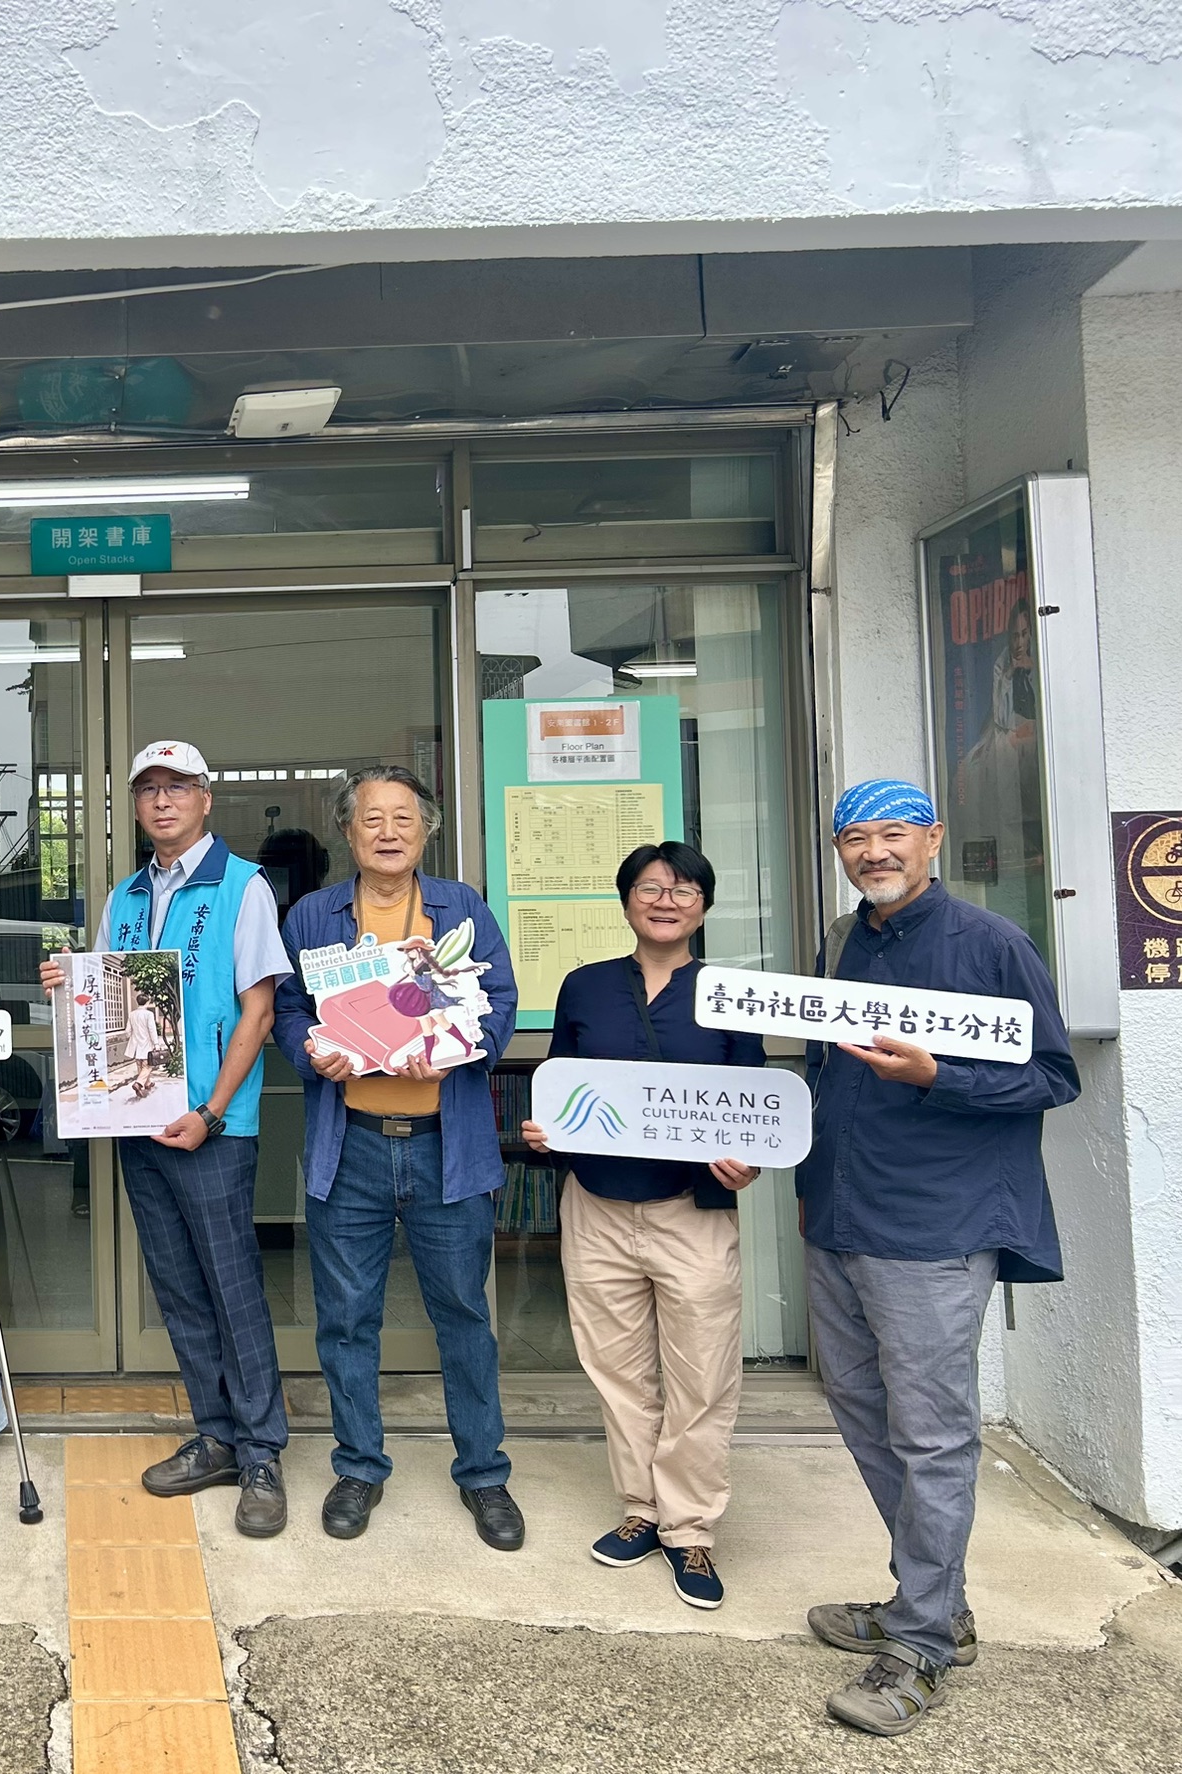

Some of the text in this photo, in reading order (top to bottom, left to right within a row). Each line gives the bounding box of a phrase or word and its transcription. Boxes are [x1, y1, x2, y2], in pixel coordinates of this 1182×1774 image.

[50, 525, 153, 549] 開架書庫
[68, 553, 135, 567] Open Stacks
[561, 742, 605, 751] Floor Plan
[117, 922, 132, 951] 許
[182, 903, 211, 987] 安南區公所
[302, 944, 345, 962] Annan
[304, 947, 384, 971] District Library
[306, 957, 391, 992] 安南圖書館
[1145, 963, 1182, 983] 停
[706, 982, 1022, 1047] 臺南社區大學台江分校
[642, 1086, 781, 1110] TAIKANG
[642, 1107, 781, 1126] CULTURAL CENTER
[642, 1124, 782, 1149] 台江文化中心
